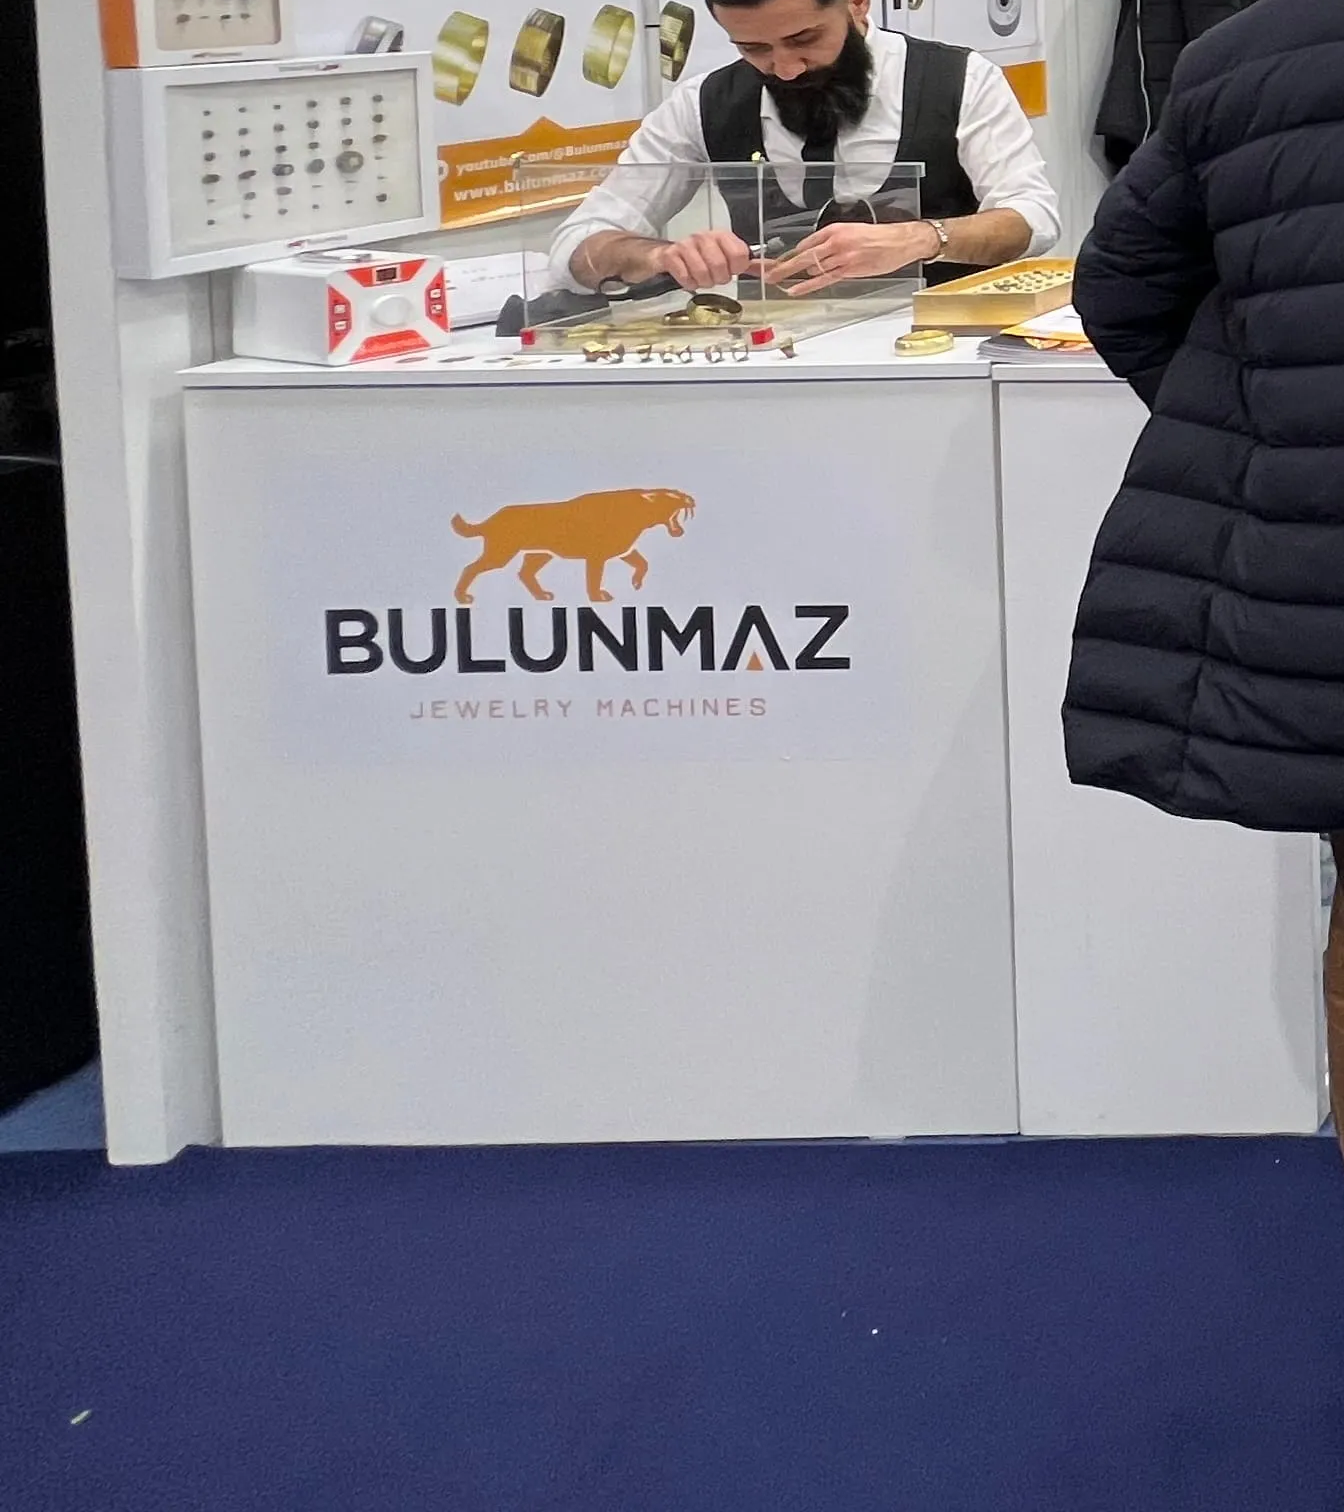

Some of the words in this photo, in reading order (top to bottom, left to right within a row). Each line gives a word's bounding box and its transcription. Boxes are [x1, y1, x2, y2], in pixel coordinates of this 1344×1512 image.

[456, 139, 627, 176] youtubecom/@Bulunmaz
[454, 166, 615, 202] www.bulunmaz.co
[325, 603, 851, 675] BULUNMAZ
[409, 698, 572, 720] JEWELRY
[596, 697, 768, 719] MACHINES
